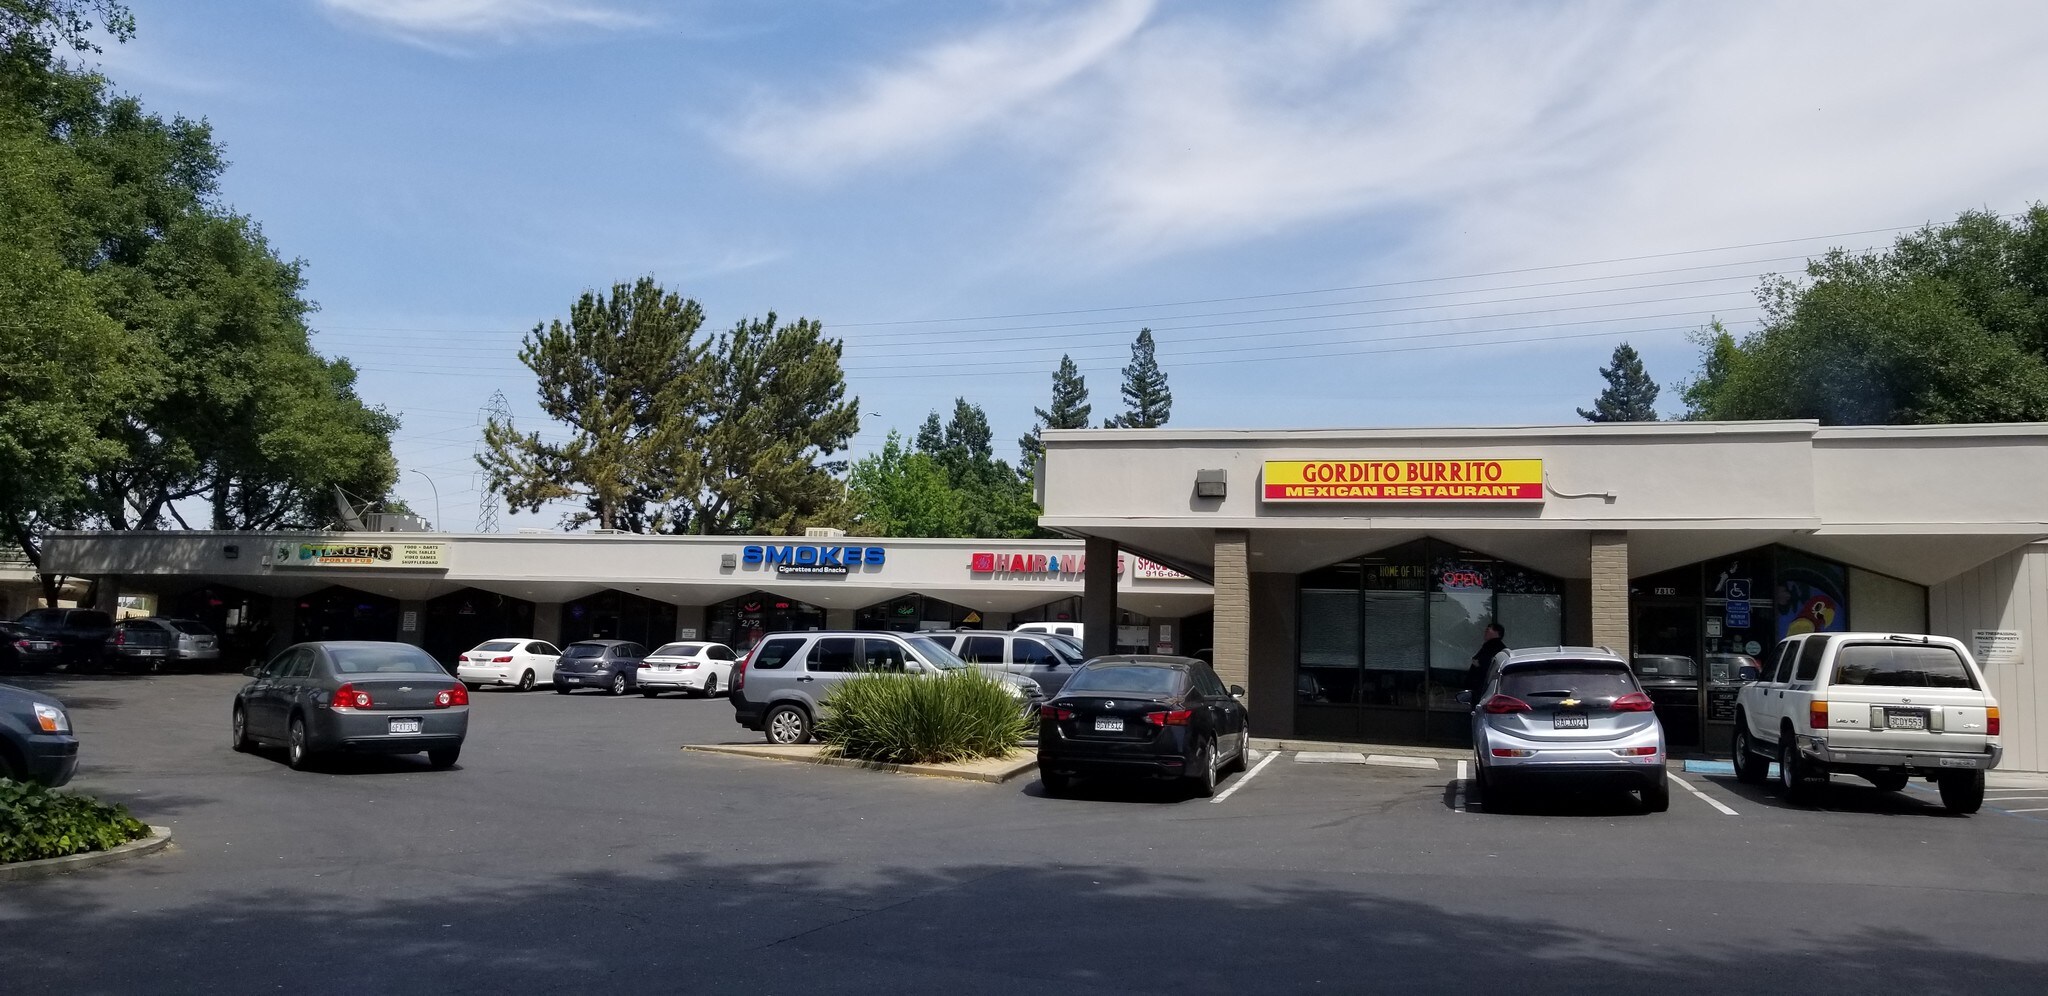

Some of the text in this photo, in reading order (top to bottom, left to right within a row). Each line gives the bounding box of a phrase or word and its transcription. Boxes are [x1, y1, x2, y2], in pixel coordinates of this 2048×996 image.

[1302, 461, 1503, 483] GORDITO BURRITO
[1285, 485, 1521, 497] MEXICAN RESTAURANT
[299, 543, 394, 562] STINGERS
[743, 545, 886, 566] SMOKES
[778, 566, 811, 574] Cigarettes
[995, 553, 1048, 573] HAIR
[1401, 565, 1410, 577] OF
[1443, 571, 1483, 586] OPEN
[1890, 717, 1923, 727] 3CDY553
